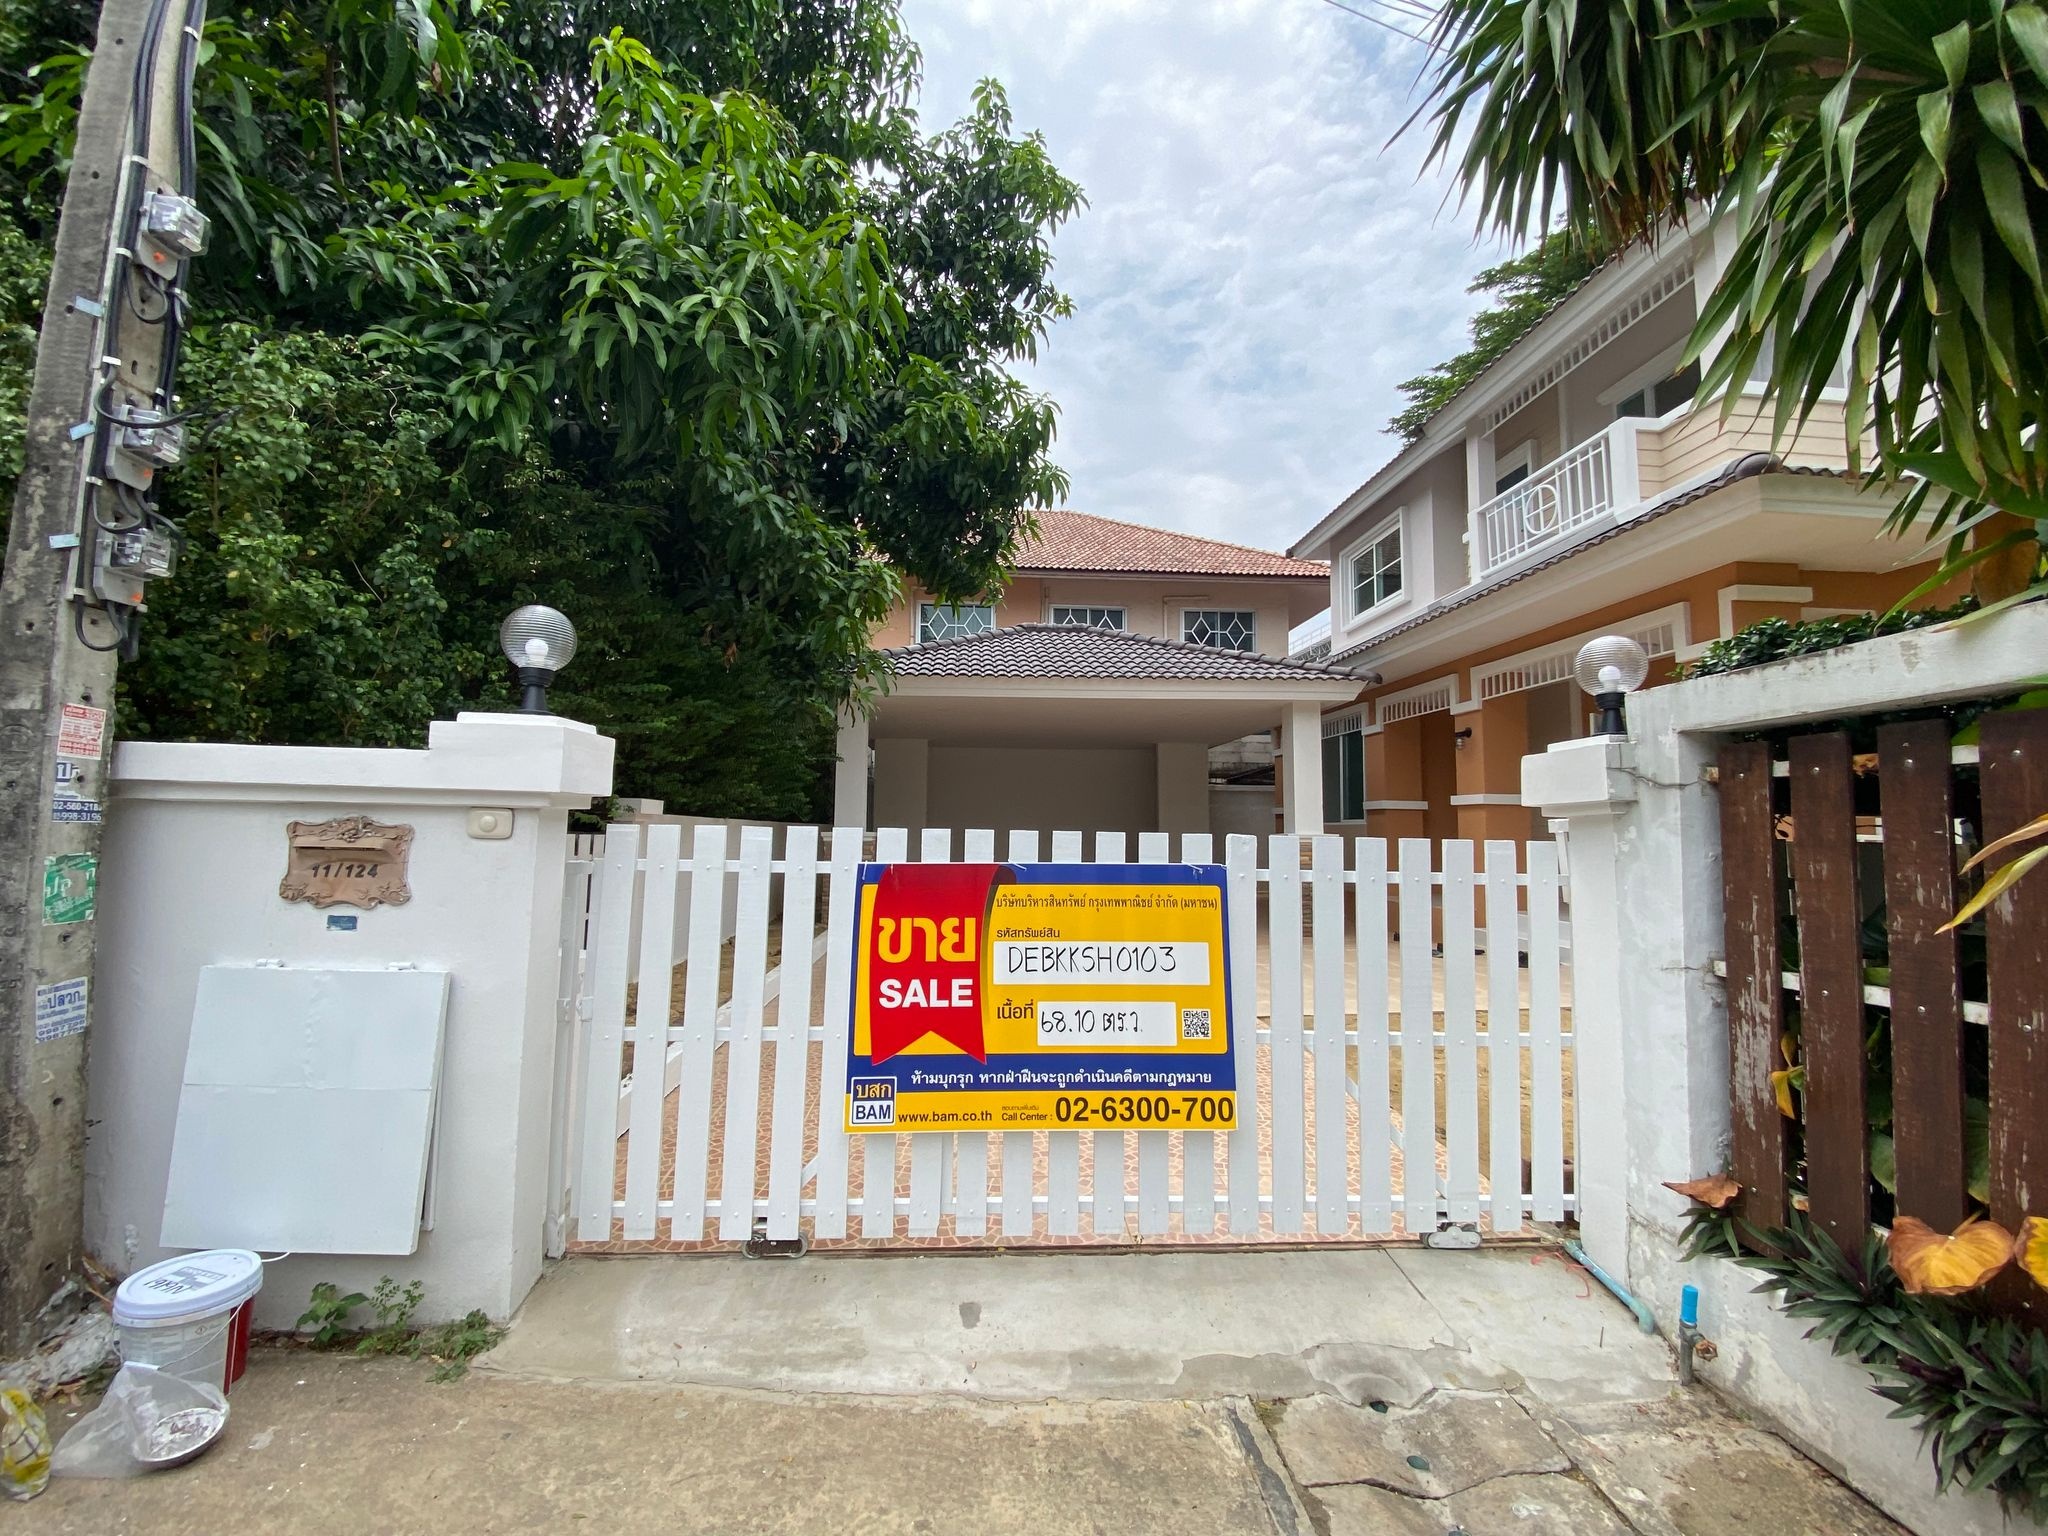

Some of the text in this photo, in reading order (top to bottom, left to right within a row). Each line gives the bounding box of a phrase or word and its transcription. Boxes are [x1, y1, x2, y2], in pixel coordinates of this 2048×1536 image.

[312, 863, 378, 879] 11/124
[996, 892, 1218, 913] บริษัทบริหารสินทรัพย์ กรุงเทพพาณิชย์ จำกัด (มหาชน)
[878, 917, 976, 963] ขาย
[996, 927, 1061, 939] รหัสทรัพย์สิน
[1008, 945, 1177, 974] DEBKKSH0103
[879, 978, 974, 1009] SALE
[996, 998, 1035, 1021] เนื้อที่
[1041, 1009, 1096, 1033] 68.10
[911, 1068, 1212, 1090] ห้ามบุกรุก หากฝ่าฝืนจะถูกดำเนินคดีตามกฎหมาย
[856, 1081, 892, 1099] บสก
[856, 1103, 892, 1121] BAM
[898, 1111, 993, 1123] www.bam.co.th
[1001, 1112, 1018, 1121] Call
[1019, 1112, 1047, 1121] Center
[1055, 1097, 1235, 1123] 02-6300-700
